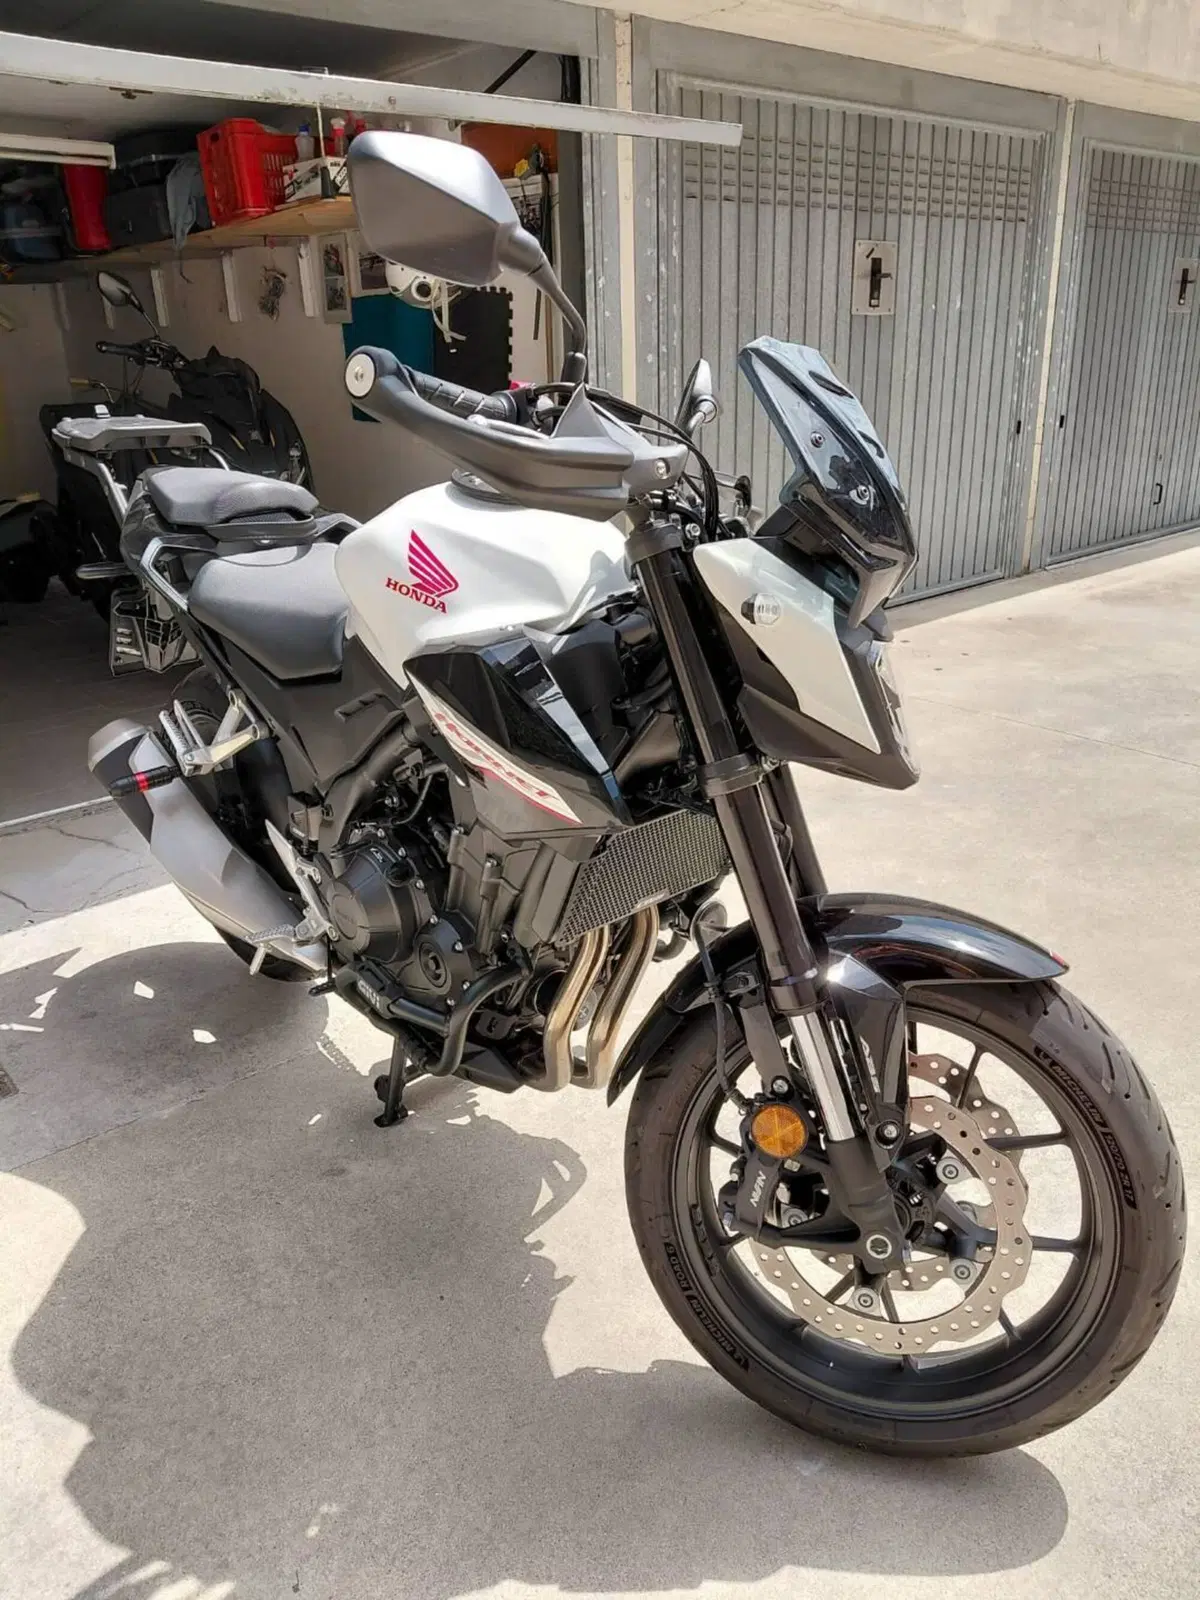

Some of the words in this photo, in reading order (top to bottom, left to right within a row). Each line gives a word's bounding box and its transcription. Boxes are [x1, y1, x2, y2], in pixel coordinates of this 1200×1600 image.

[385, 577, 447, 614] HONDA
[1051, 1064, 1104, 1125] MICHELIN
[670, 1255, 691, 1290] ROAD
[688, 1296, 735, 1351] MICHELIN
